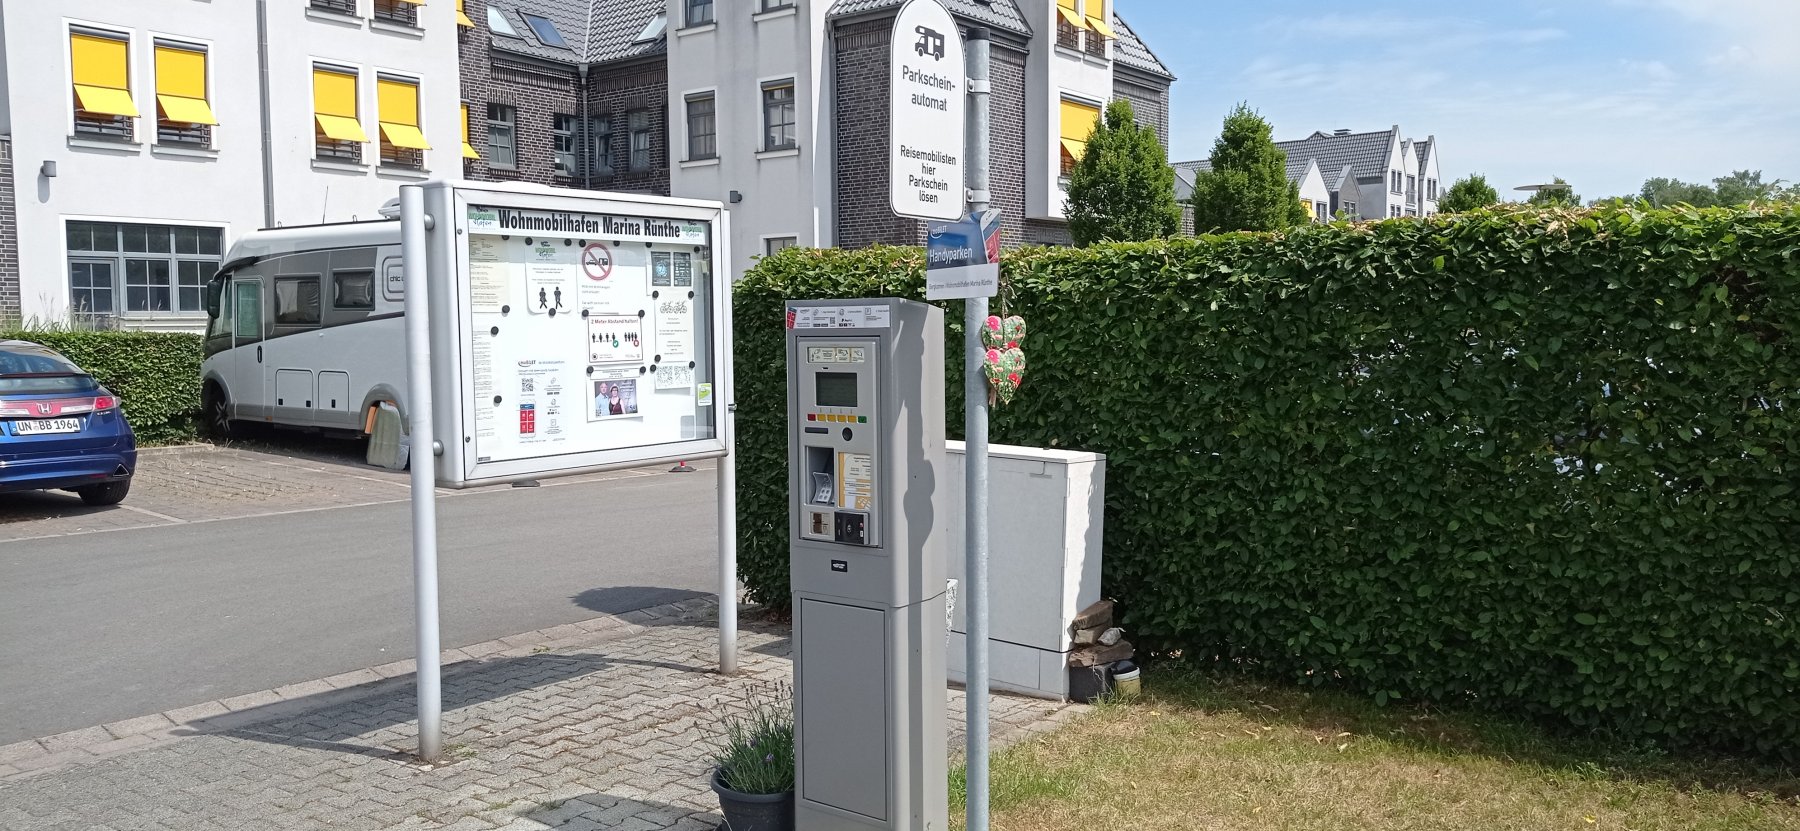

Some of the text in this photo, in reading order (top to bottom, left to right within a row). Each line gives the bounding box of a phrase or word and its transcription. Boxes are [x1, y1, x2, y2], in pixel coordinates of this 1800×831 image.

[902, 65, 956, 91] Parkschein-
[911, 92, 948, 112] automat
[900, 144, 957, 166] Reisemobilisten
[921, 163, 937, 176] hier
[908, 174, 948, 192] Parkschein
[919, 190, 938, 204] lösen
[498, 208, 599, 234] Wohnmobilhafen
[602, 216, 641, 236] Marina
[644, 218, 681, 238] Rünthe
[929, 245, 973, 265] Handyparken
[17, 419, 79, 432] UN BB 1964
